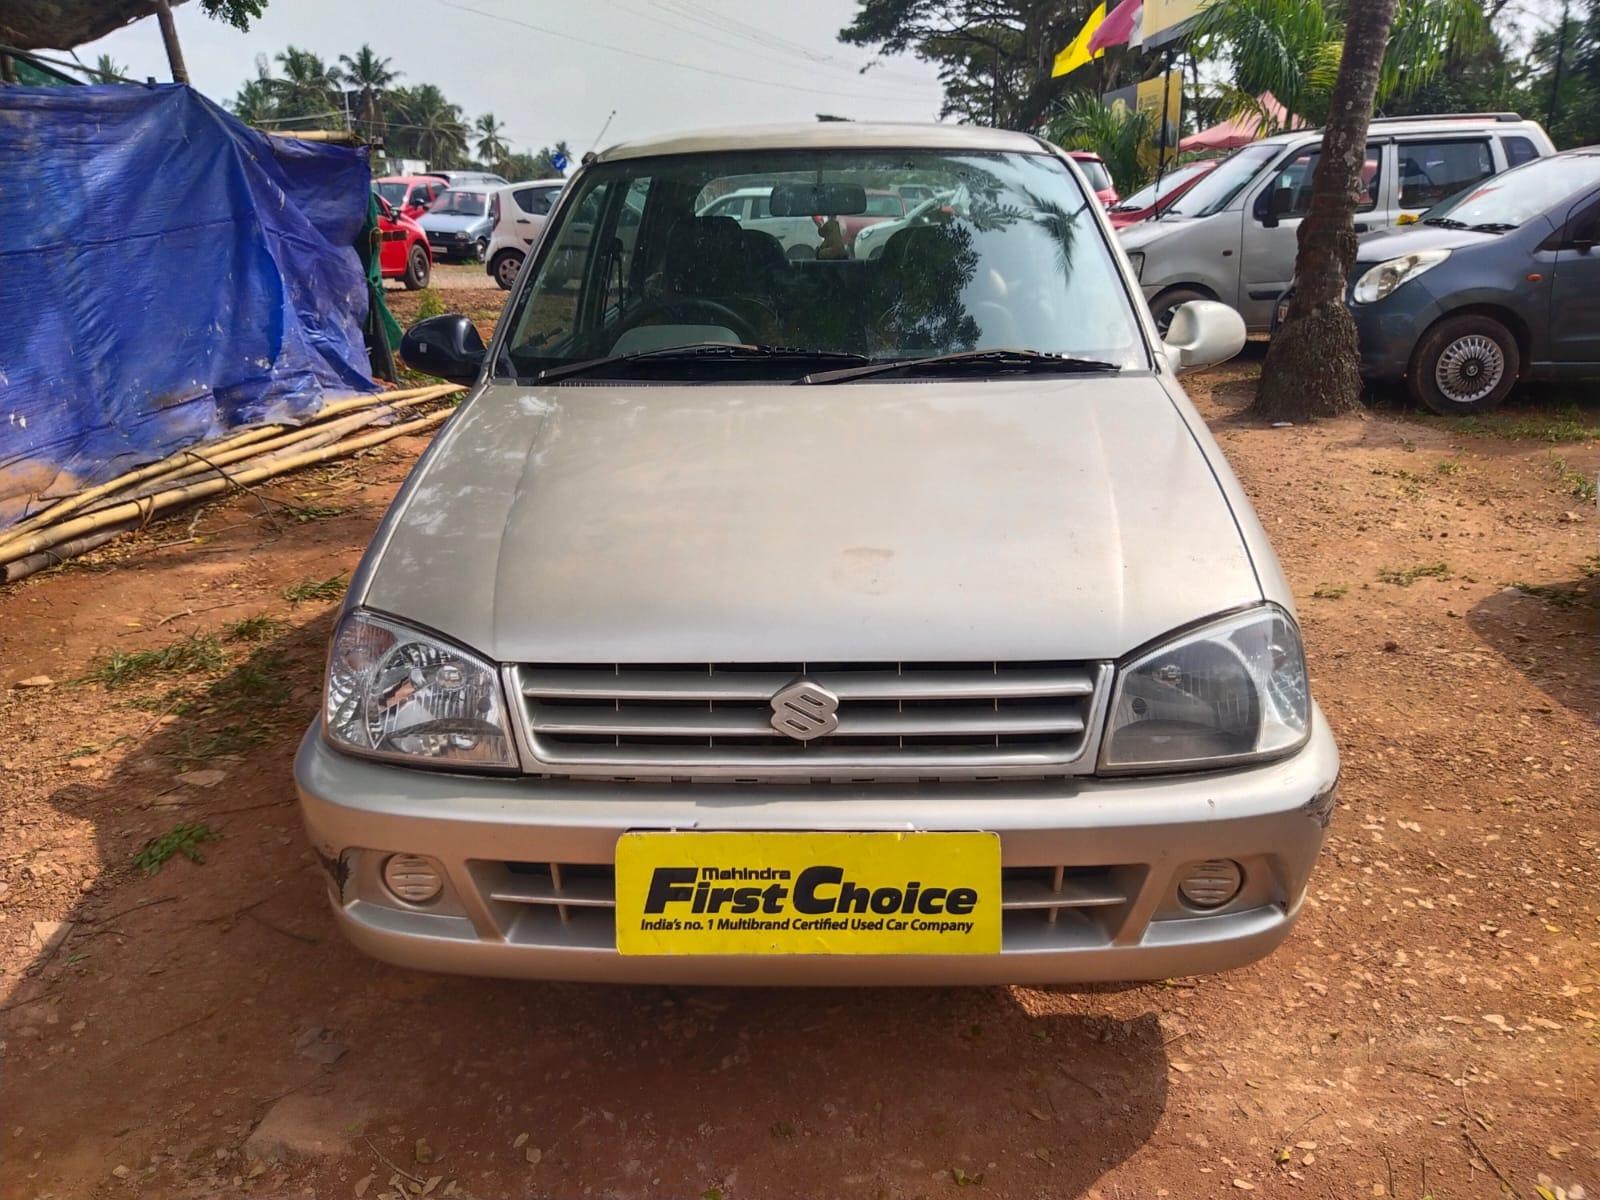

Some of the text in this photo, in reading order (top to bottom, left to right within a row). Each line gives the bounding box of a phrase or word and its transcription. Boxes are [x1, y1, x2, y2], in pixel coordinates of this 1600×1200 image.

[643, 865, 978, 915] First Choice
[683, 919, 704, 931] no.
[707, 918, 714, 930] 1
[717, 917, 791, 931] Multibrand
[792, 918, 849, 931] Certified
[851, 918, 884, 931] Used
[885, 918, 909, 931] Car
[910, 918, 974, 934] Company
